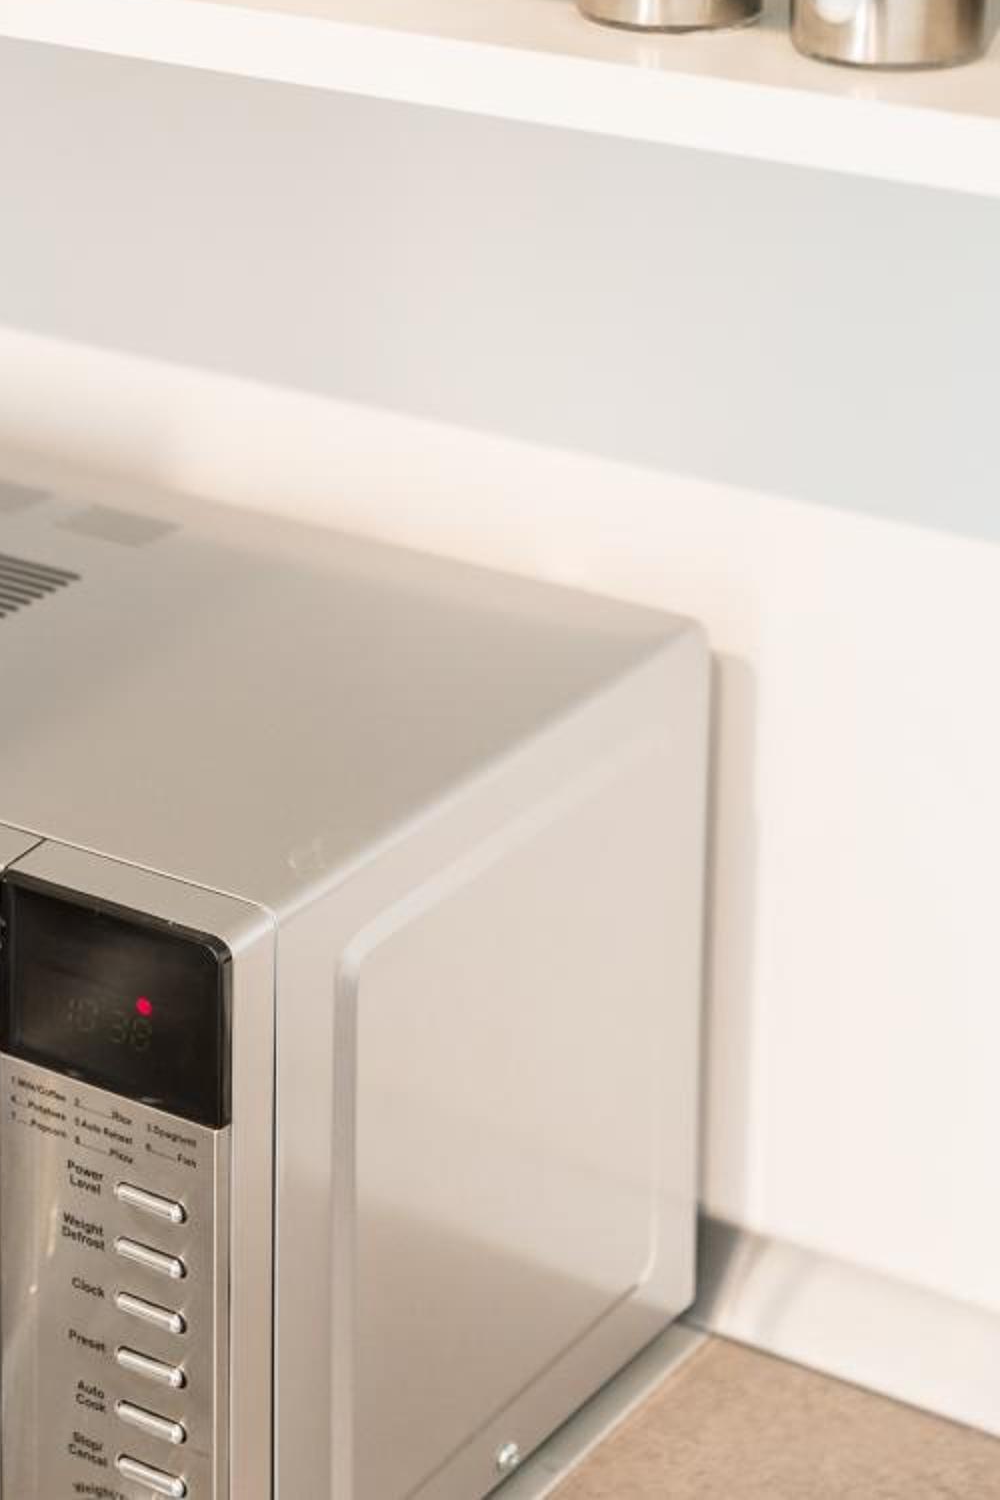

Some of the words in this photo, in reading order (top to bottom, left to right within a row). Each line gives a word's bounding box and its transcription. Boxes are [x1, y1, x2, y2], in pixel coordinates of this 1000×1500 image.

[67, 1159, 103, 1181] Power
[69, 1173, 102, 1195] Level
[63, 1211, 104, 1235] Weight
[61, 1225, 105, 1251] Defrost
[71, 1276, 105, 1299] Clock
[68, 1327, 105, 1352] Preset
[77, 1380, 105, 1399] Auto
[75, 1393, 106, 1413] Cook
[68, 1443, 108, 1468] Cancel
